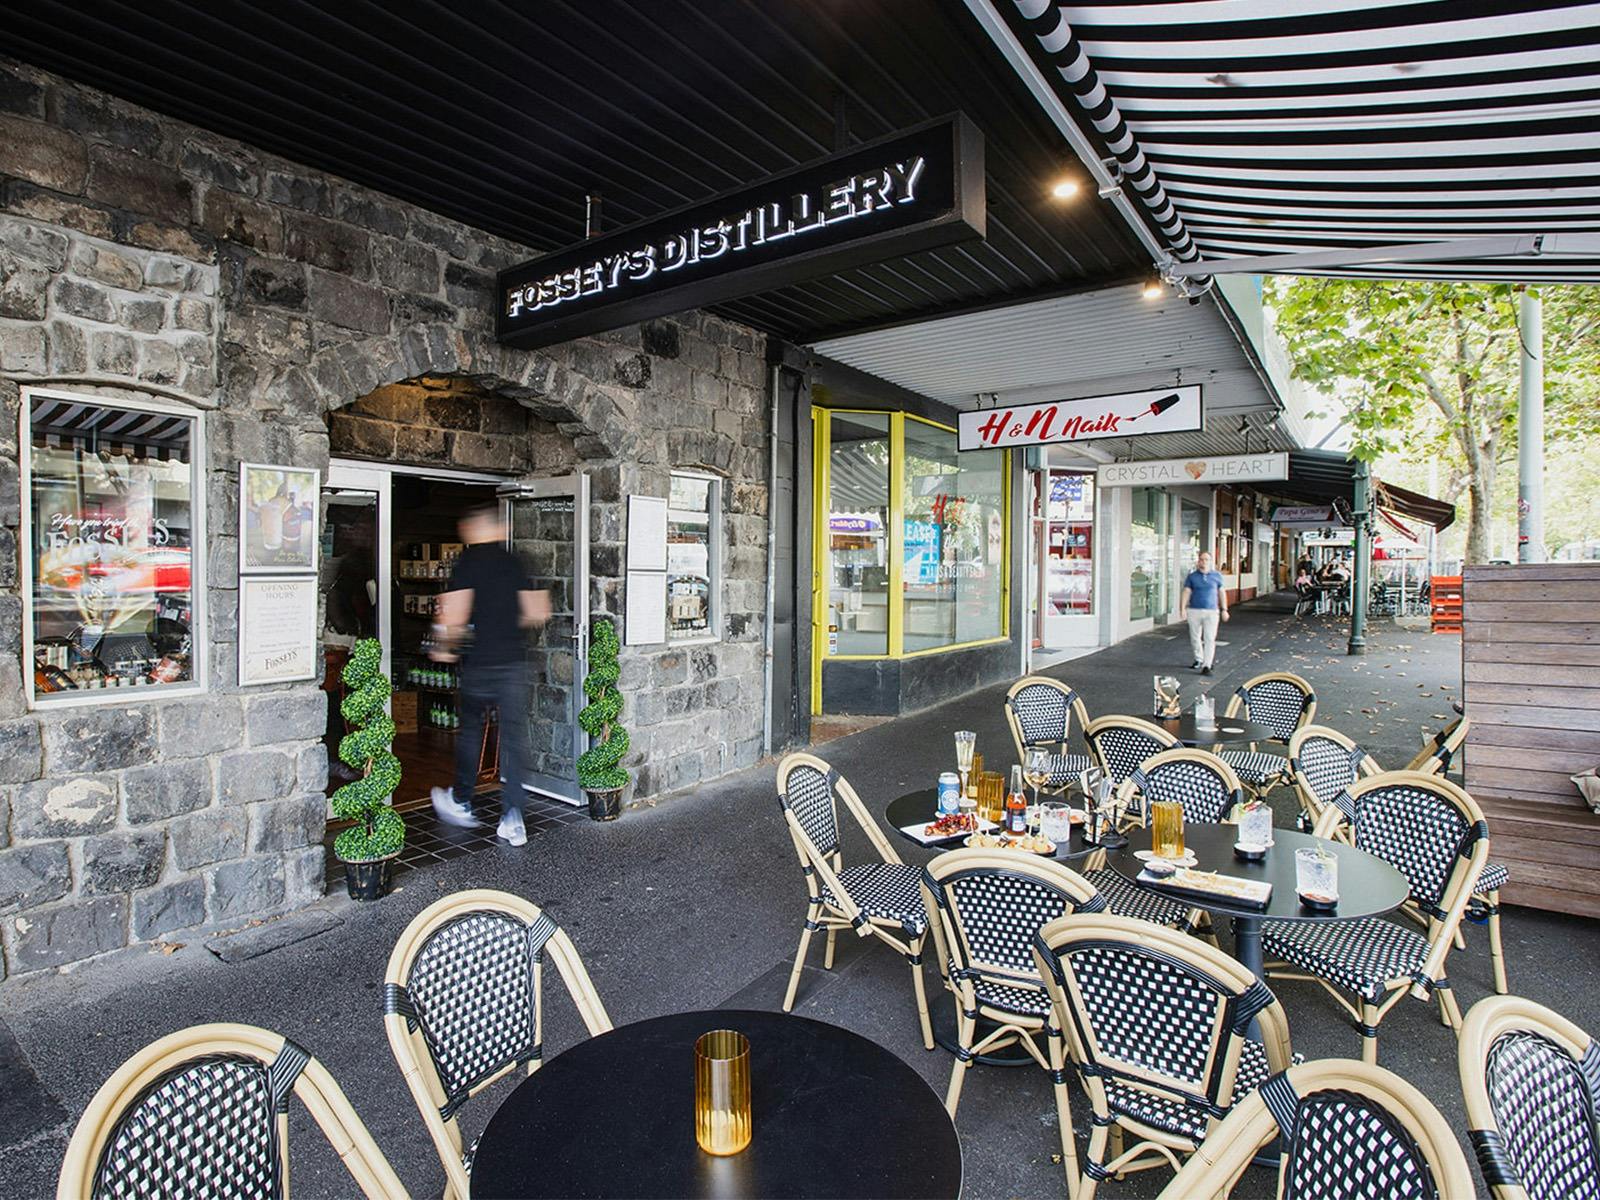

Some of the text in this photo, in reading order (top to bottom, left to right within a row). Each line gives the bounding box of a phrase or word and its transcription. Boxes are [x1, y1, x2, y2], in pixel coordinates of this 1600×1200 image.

[506, 155, 927, 319] FOSSEY'S DISTILLERY
[1105, 459, 1275, 481] CRYSTAL HEART
[261, 583, 298, 592] OPENING
[265, 592, 297, 601] HOURS
